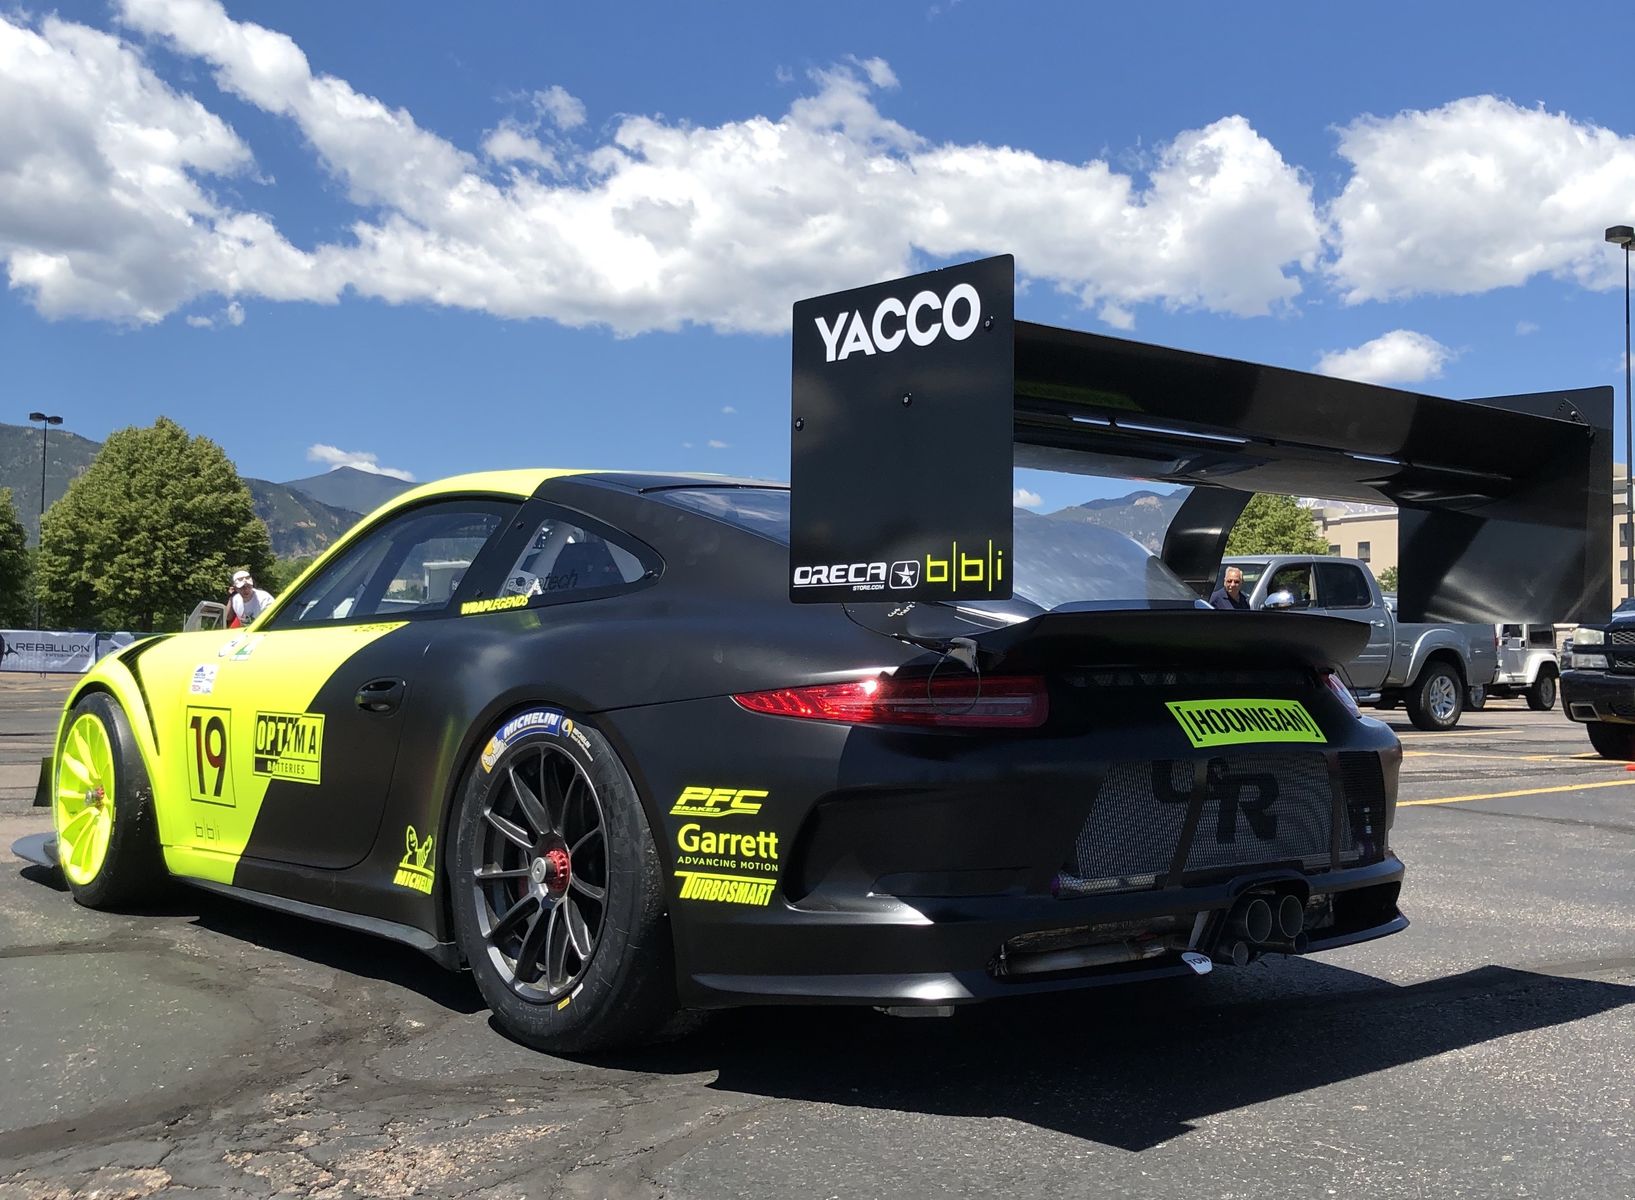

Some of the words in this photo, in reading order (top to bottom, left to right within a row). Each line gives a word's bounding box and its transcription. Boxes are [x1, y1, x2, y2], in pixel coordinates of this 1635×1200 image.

[814, 283, 981, 363] YACCO
[793, 562, 887, 585] ORECA
[461, 595, 529, 615] WRAPLEGENDS
[15, 643, 91, 653] REBELLION
[256, 720, 317, 755] OPTIMA
[503, 712, 560, 739] MICHELIN
[190, 716, 227, 797] 19
[267, 760, 305, 775] BATTERIES
[675, 786, 769, 809] PFC
[677, 823, 779, 859] Garrett
[677, 856, 737, 869] ADVANCING
[740, 861, 779, 872] MOTION
[674, 871, 777, 907] TURBOSMART
